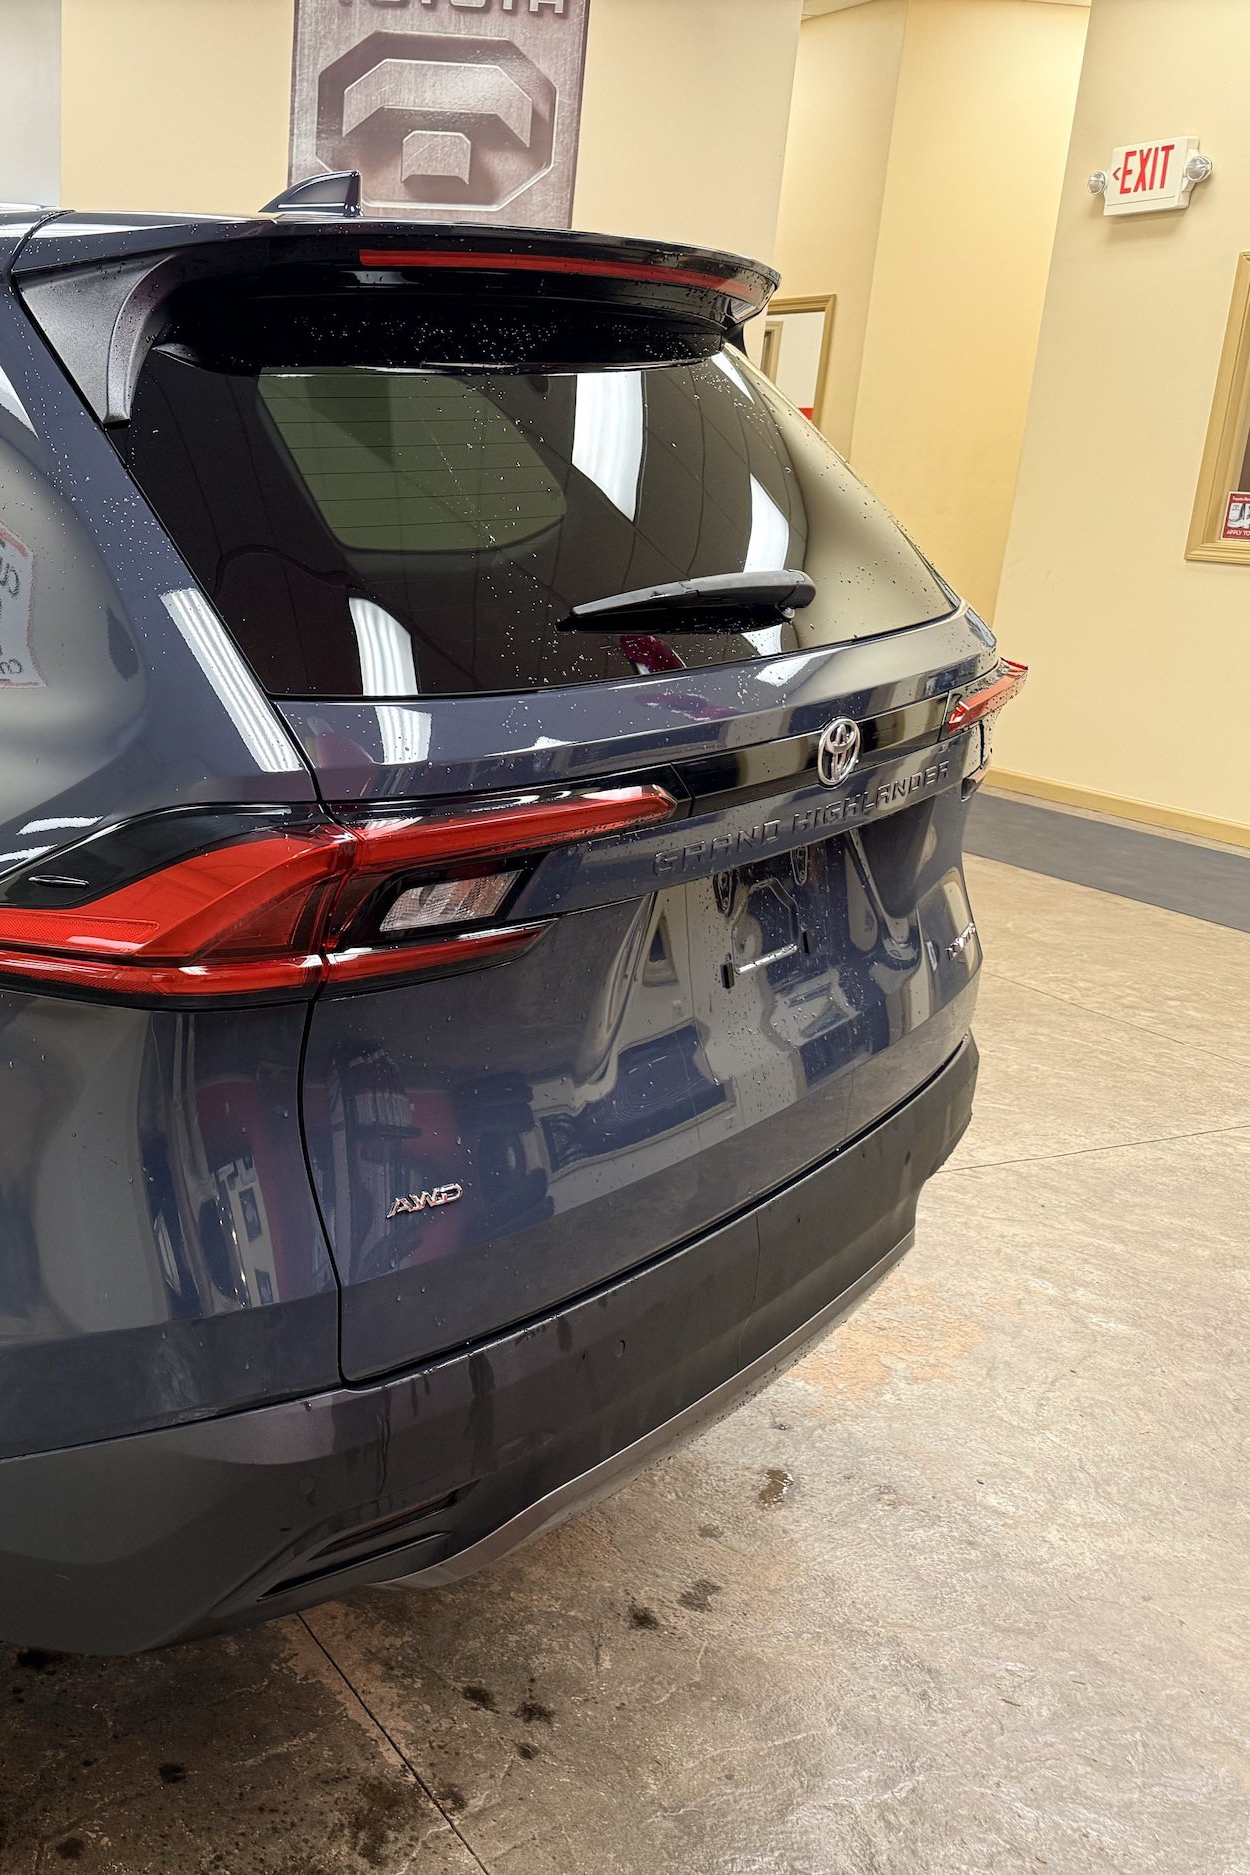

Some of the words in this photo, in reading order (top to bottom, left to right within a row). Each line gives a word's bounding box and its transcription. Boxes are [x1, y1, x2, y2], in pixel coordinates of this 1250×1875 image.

[1119, 144, 1175, 195] EXIT
[654, 819, 781, 876] GRAND
[793, 761, 950, 835] HIGHLANDER
[386, 1183, 463, 1218] AWD
